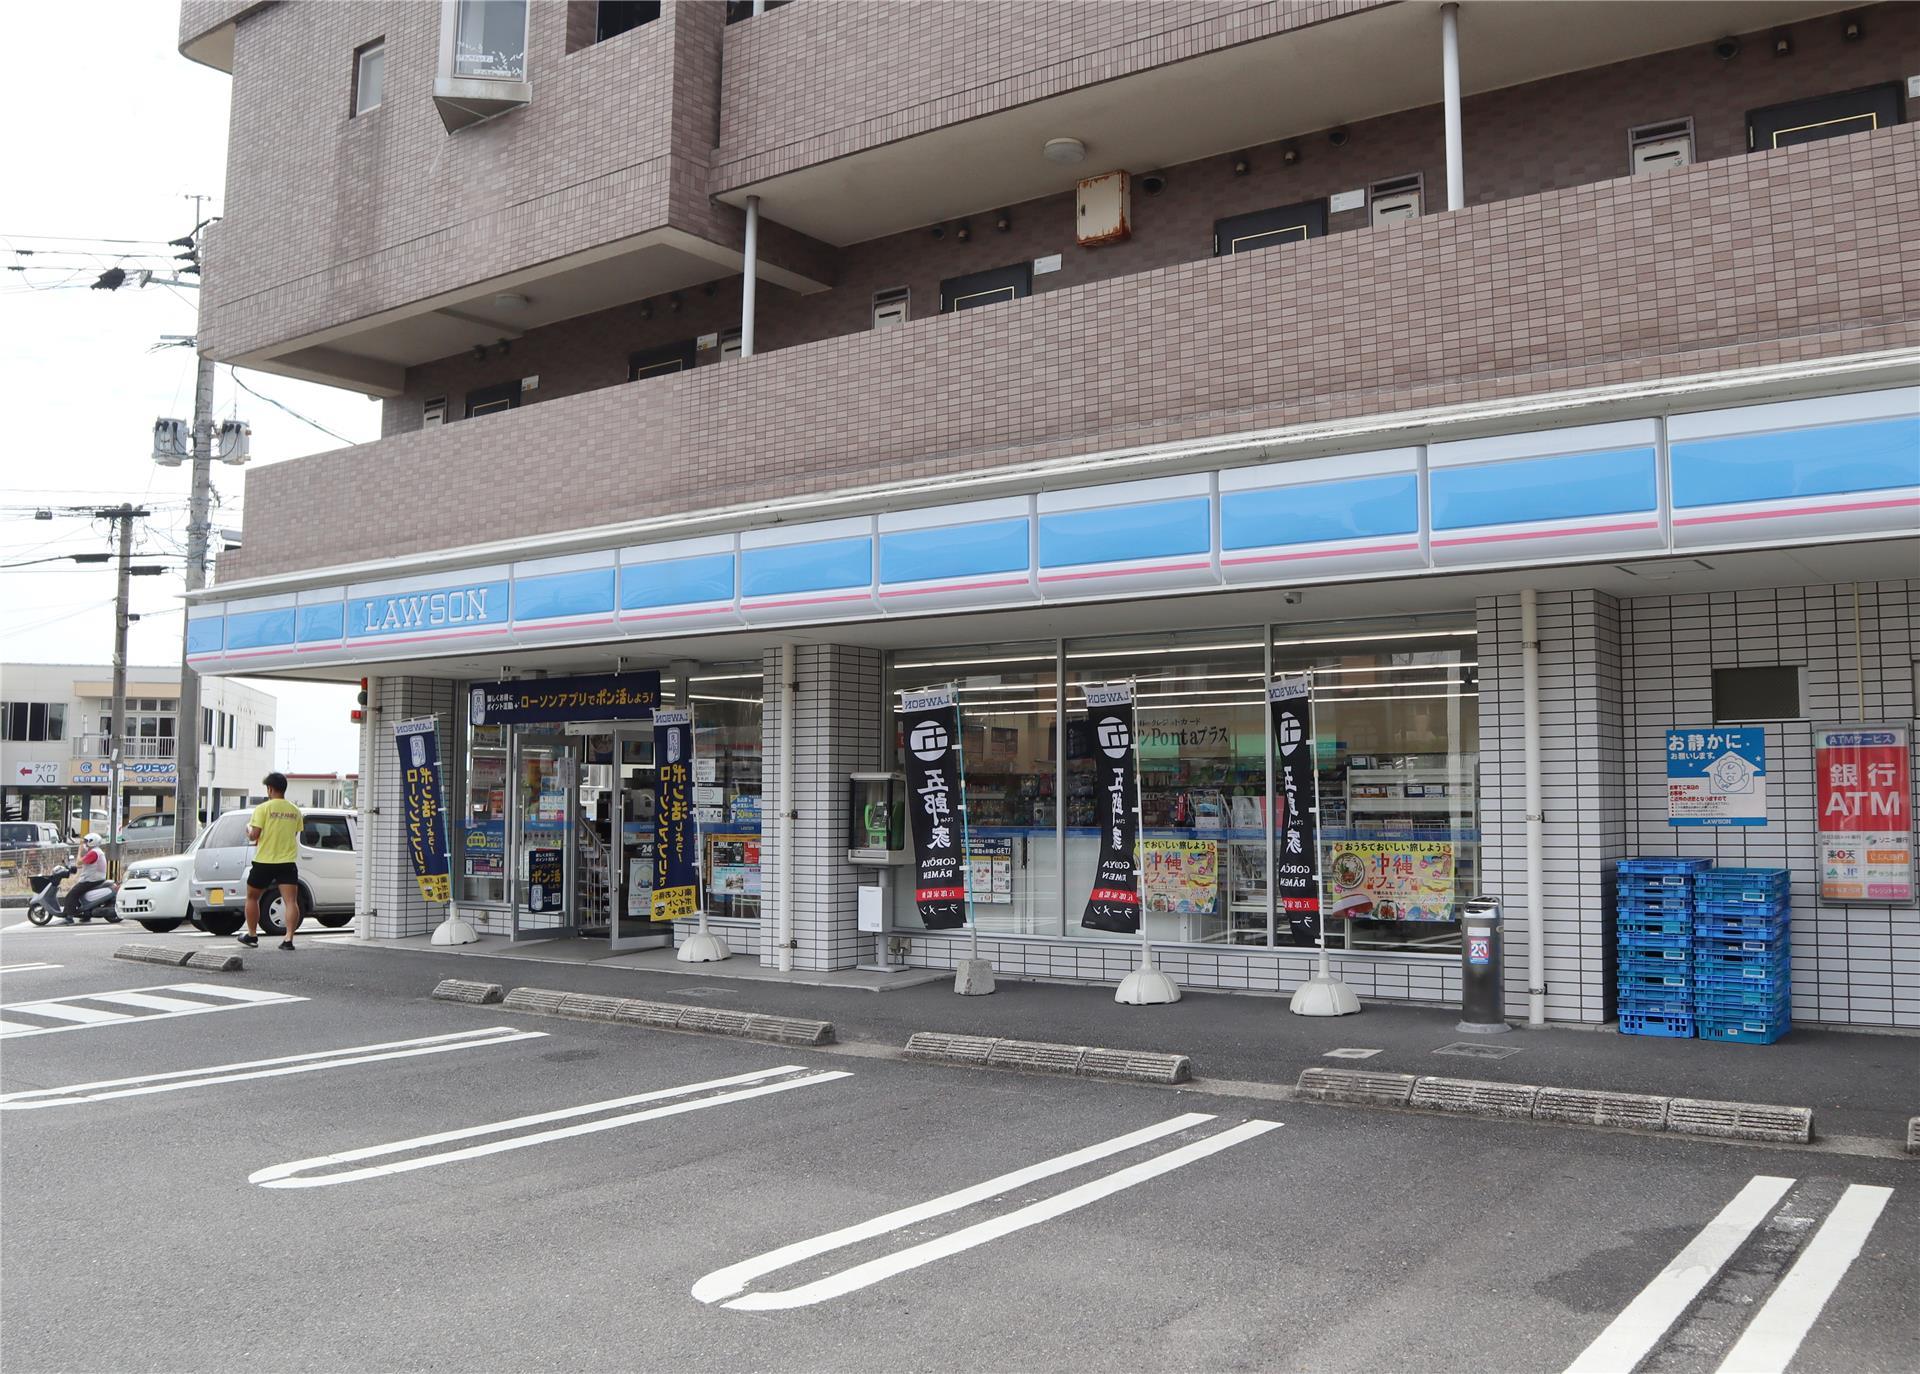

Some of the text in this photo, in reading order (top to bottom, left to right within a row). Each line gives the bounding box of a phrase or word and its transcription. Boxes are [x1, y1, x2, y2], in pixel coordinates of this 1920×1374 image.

[365, 588, 488, 632] LAWSON
[1668, 734, 1742, 751] お静かに
[1828, 733, 1893, 745] ATMサービス
[35, 774, 56, 783] 入口
[1830, 763, 1896, 787] 銀行
[1825, 791, 1900, 816] ATM
[1344, 842, 1442, 852] おうちでおいしい旅しよう
[1146, 851, 1183, 871] 沖縄
[1371, 852, 1414, 876] 沖縄
[531, 869, 561, 884] ポン活
[1375, 876, 1410, 889] フェア
[1471, 943, 1488, 957] 20
